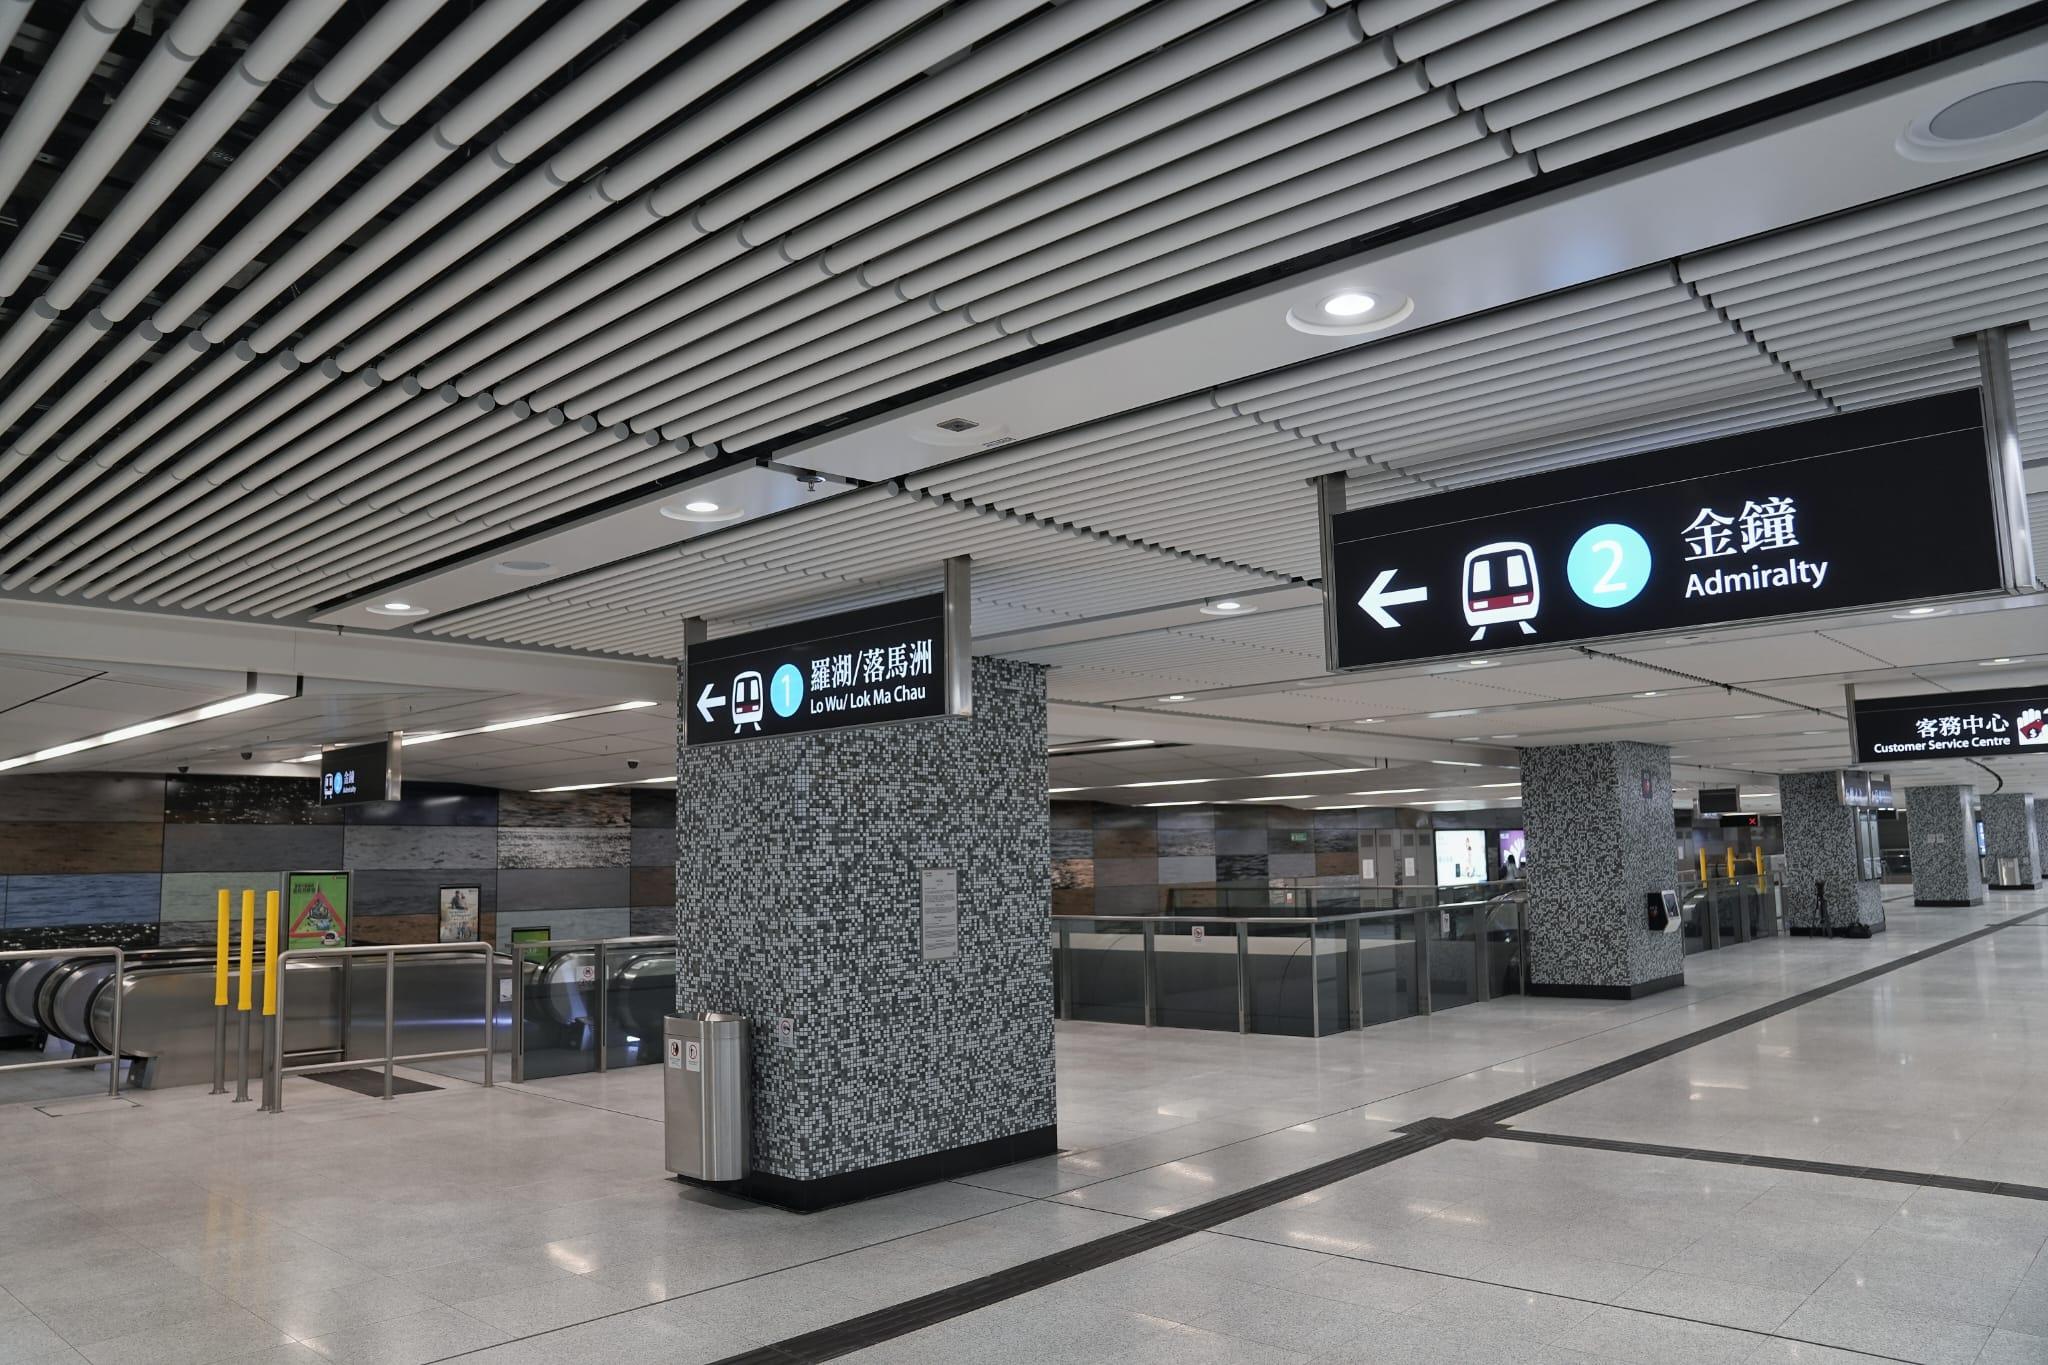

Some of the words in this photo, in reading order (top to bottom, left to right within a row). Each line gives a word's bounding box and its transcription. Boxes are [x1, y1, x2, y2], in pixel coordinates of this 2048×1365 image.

[1681, 497, 1800, 562] 金鐘
[1591, 539, 1628, 594] 2
[1685, 558, 1829, 599] Admiralty
[810, 639, 933, 692] 羅湖/落馬洲
[780, 673, 791, 708] 1
[810, 698, 824, 715] Lo
[825, 693, 849, 712] Wu/
[850, 690, 871, 709] Lok
[873, 688, 892, 706] Ma
[894, 684, 926, 703] Chau
[1874, 741, 1926, 754] Customer
[1928, 738, 1969, 750] Service
[1971, 736, 2011, 748] Centre
[1915, 713, 2010, 739] 客務中心
